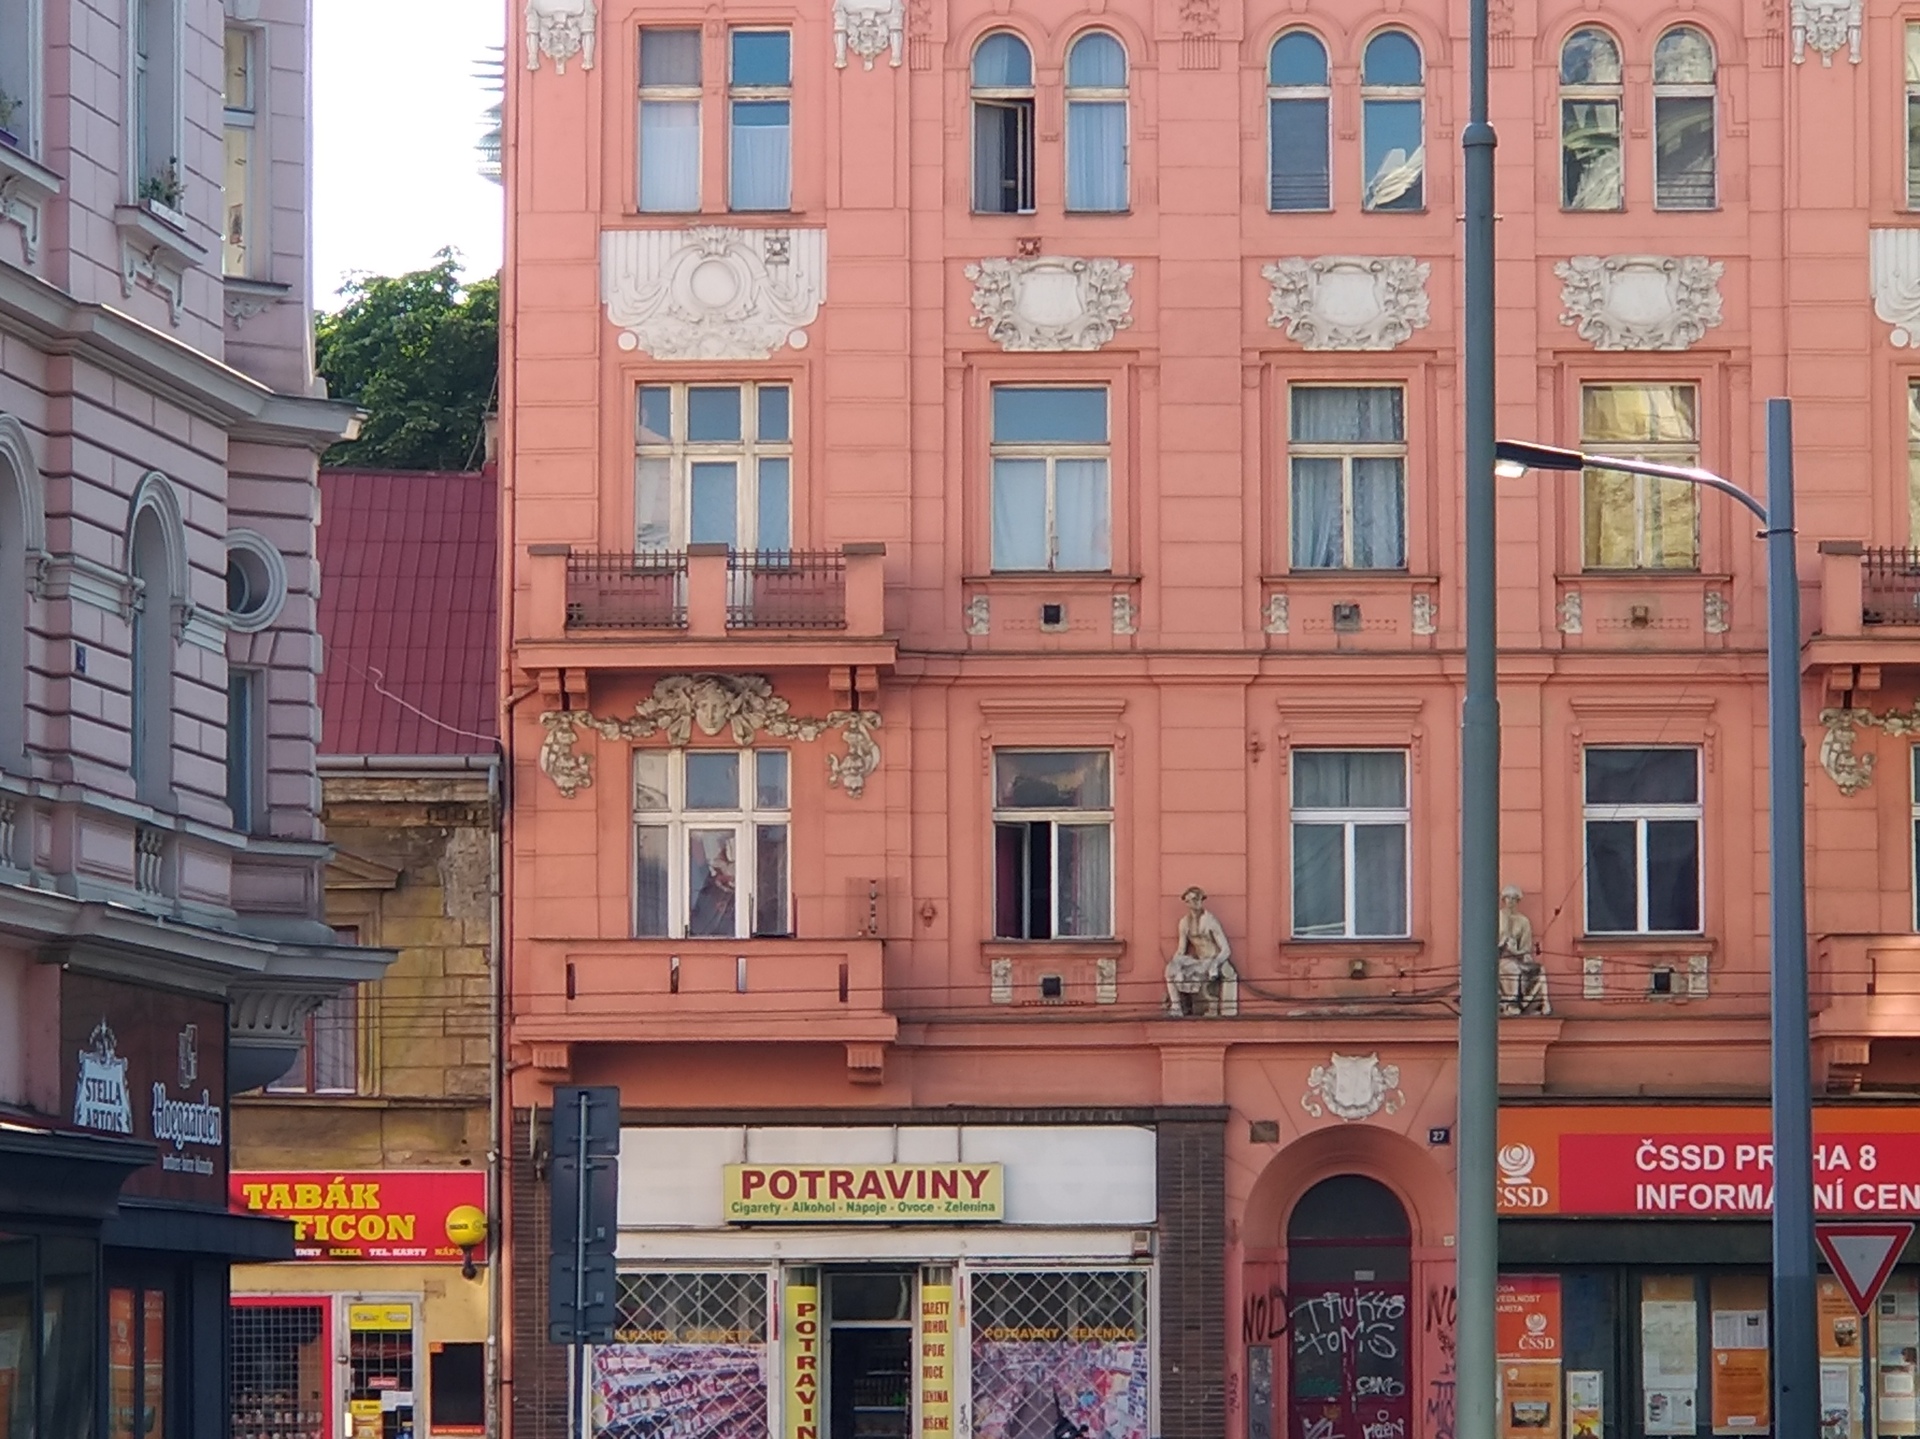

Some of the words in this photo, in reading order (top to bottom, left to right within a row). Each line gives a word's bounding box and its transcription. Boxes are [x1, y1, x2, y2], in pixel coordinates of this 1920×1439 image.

[86, 1077, 123, 1106] STELLA
[85, 1107, 123, 1132] ARTOIS
[152, 1081, 222, 1151] Hoegaarden
[1432, 1130, 1445, 1142] 27
[1636, 1138, 1726, 1171] ČSSD
[1735, 1144, 1852, 1171] PRHA
[1859, 1144, 1877, 1171] 8
[243, 1176, 380, 1210] TABÁK
[741, 1169, 990, 1200] POTRAVINY
[1636, 1178, 1844, 1210] INFORMNÍ
[1853, 1183, 1920, 1211] CEN
[731, 1202, 782, 1216] Cigarety
[792, 1201, 835, 1214] Alkohol
[846, 1201, 887, 1215] Nápoje
[898, 1201, 934, 1214] Ovoce
[289, 1214, 416, 1241] FICON
[1518, 1334, 1555, 1350] ČSSD
